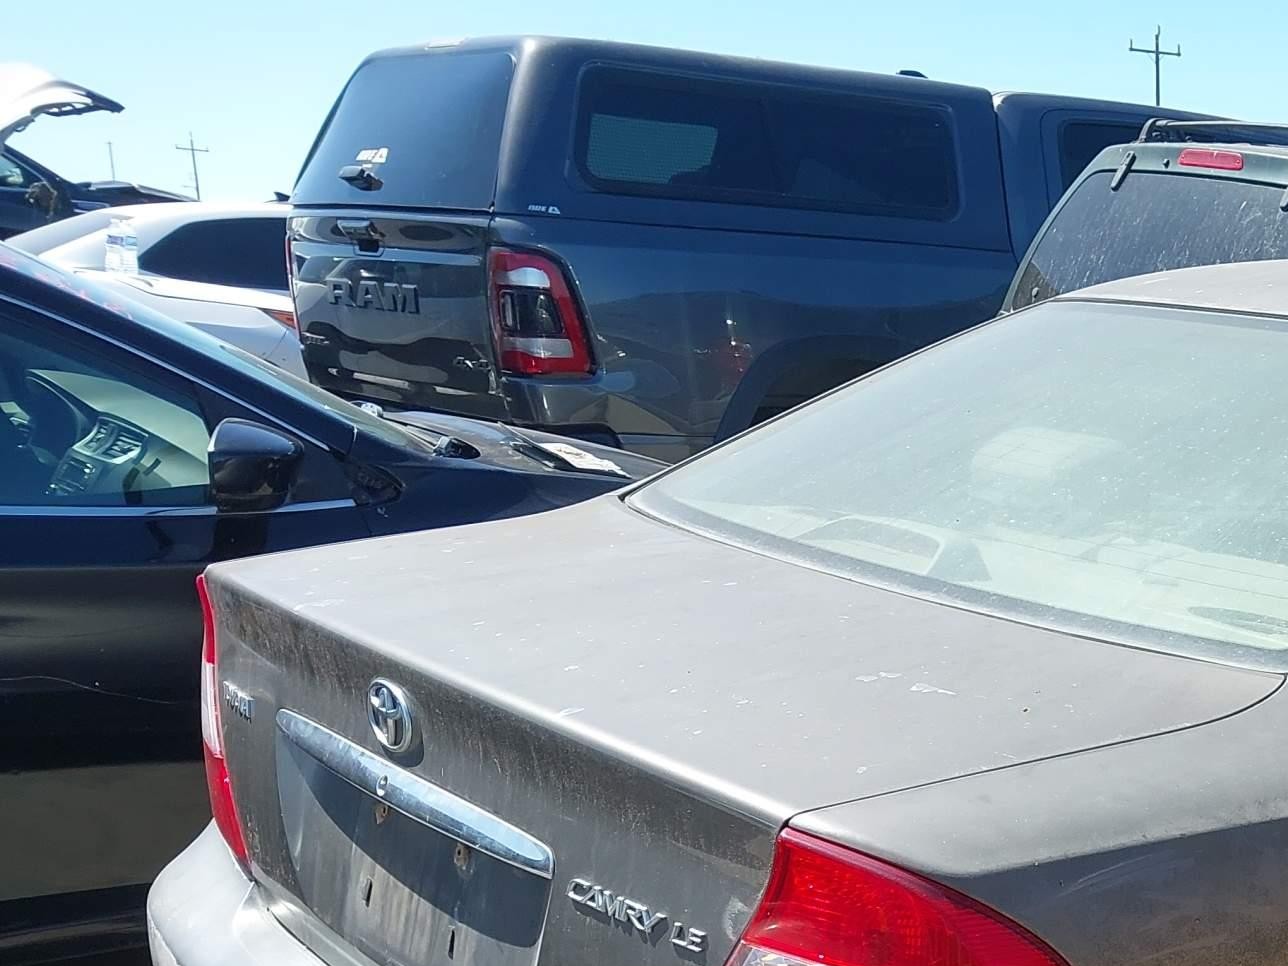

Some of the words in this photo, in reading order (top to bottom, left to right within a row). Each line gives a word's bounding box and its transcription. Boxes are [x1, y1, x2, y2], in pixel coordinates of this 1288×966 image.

[326, 278, 420, 314] RAM
[565, 878, 668, 934] CAMRY
[669, 921, 708, 952] LE
